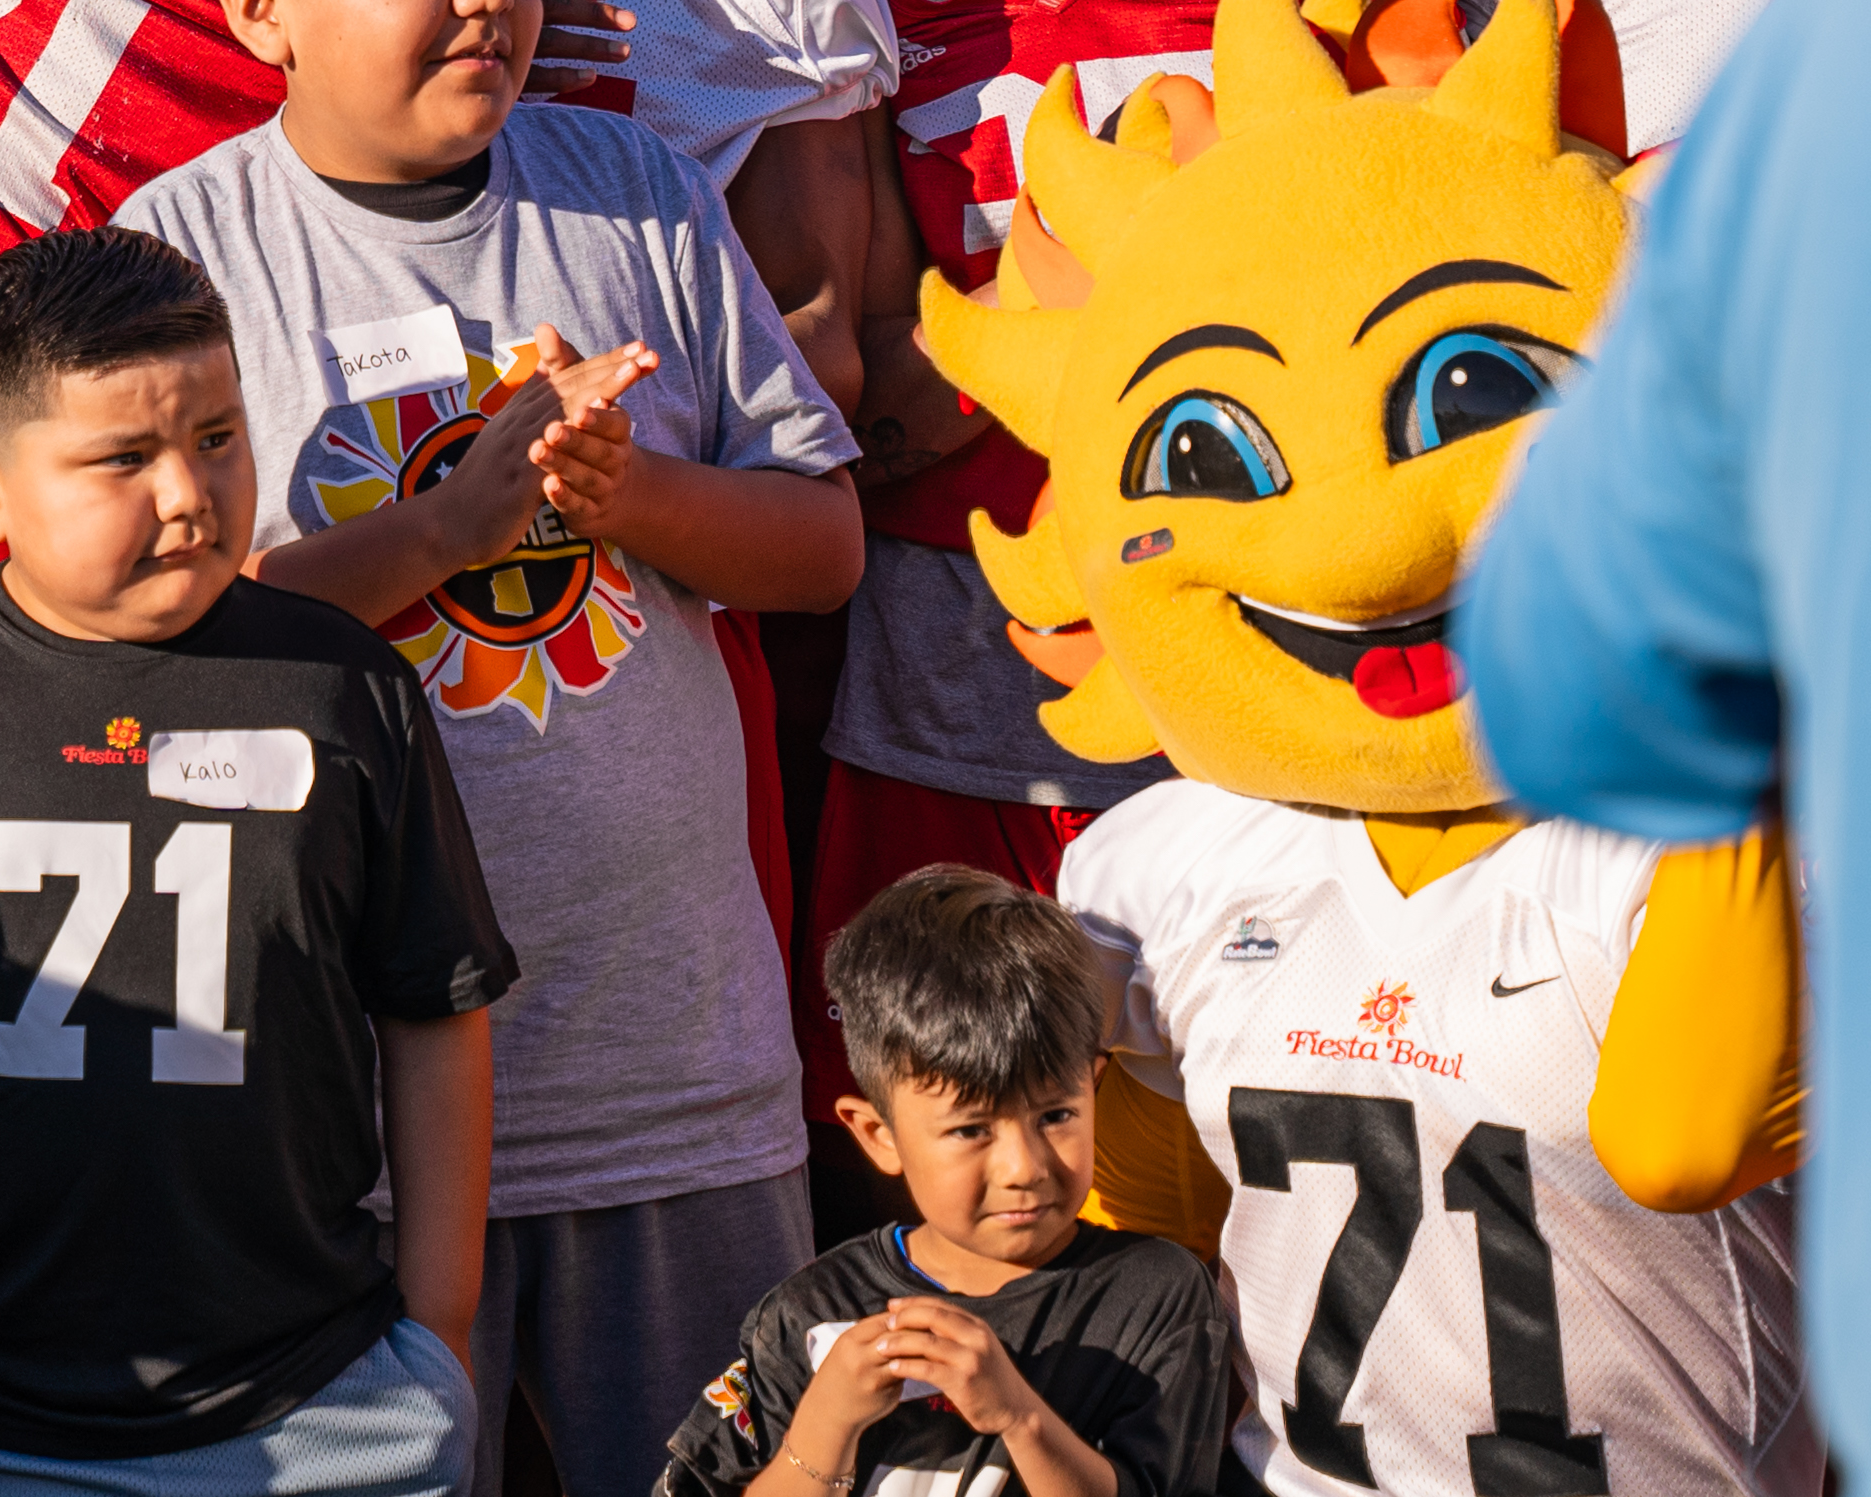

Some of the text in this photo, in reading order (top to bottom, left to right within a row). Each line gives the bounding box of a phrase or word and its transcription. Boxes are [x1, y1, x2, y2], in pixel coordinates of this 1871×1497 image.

[61, 745, 126, 766] Fiesta
[1286, 1030, 1464, 1080] Fiesta Bowl
[1228, 1086, 1609, 1497] 71
